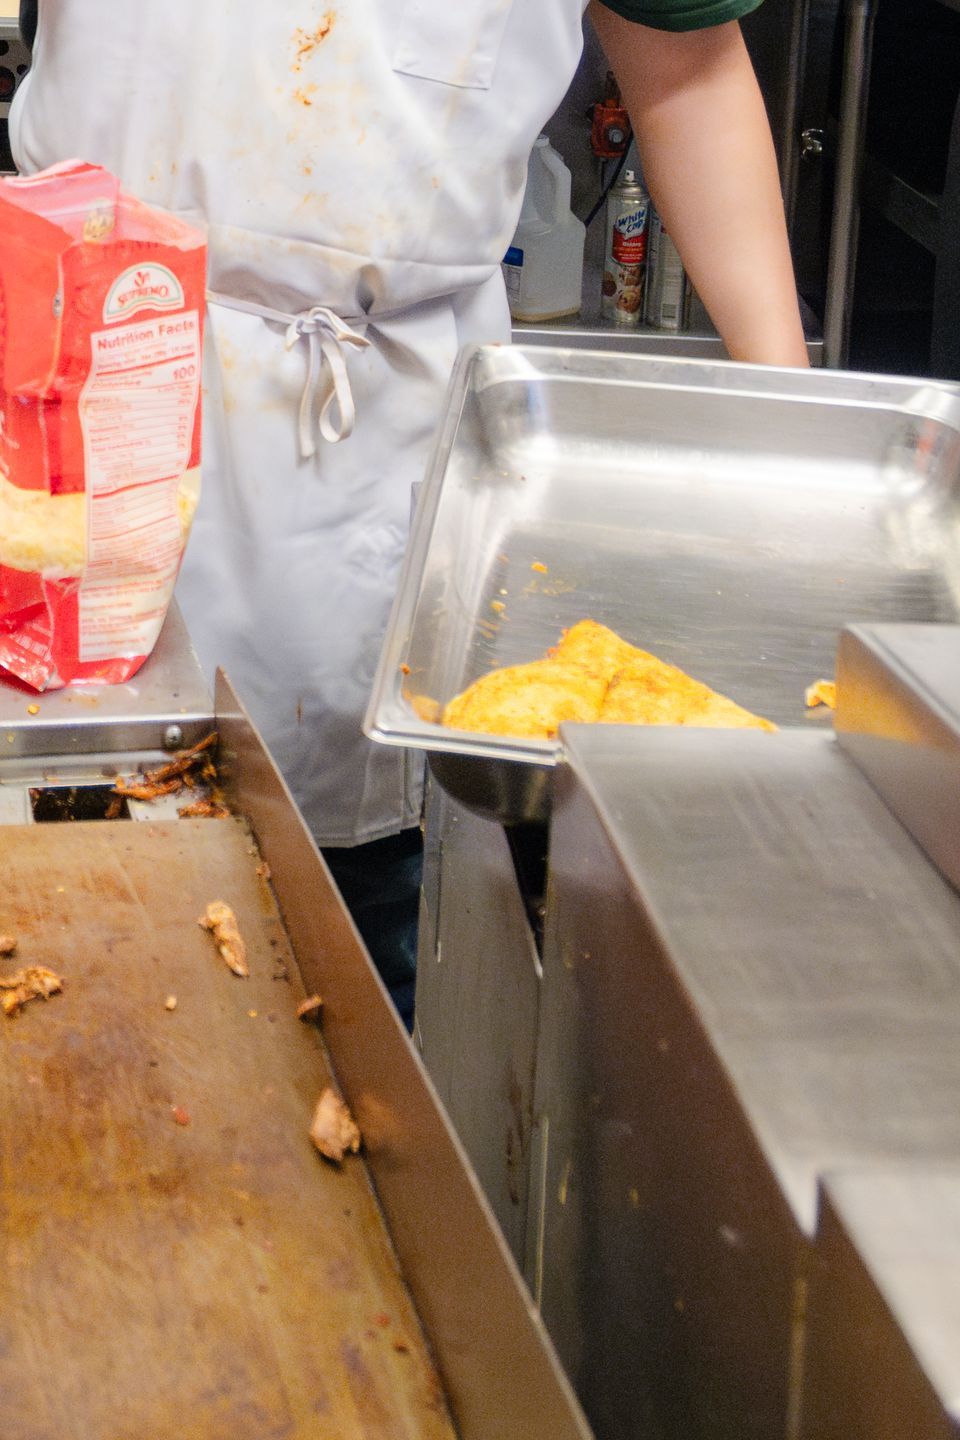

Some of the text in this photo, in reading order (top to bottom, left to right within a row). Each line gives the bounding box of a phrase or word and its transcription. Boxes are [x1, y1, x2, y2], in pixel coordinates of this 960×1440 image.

[97, 320, 195, 351] Nutrition Facts
[172, 364, 195, 380] 100
